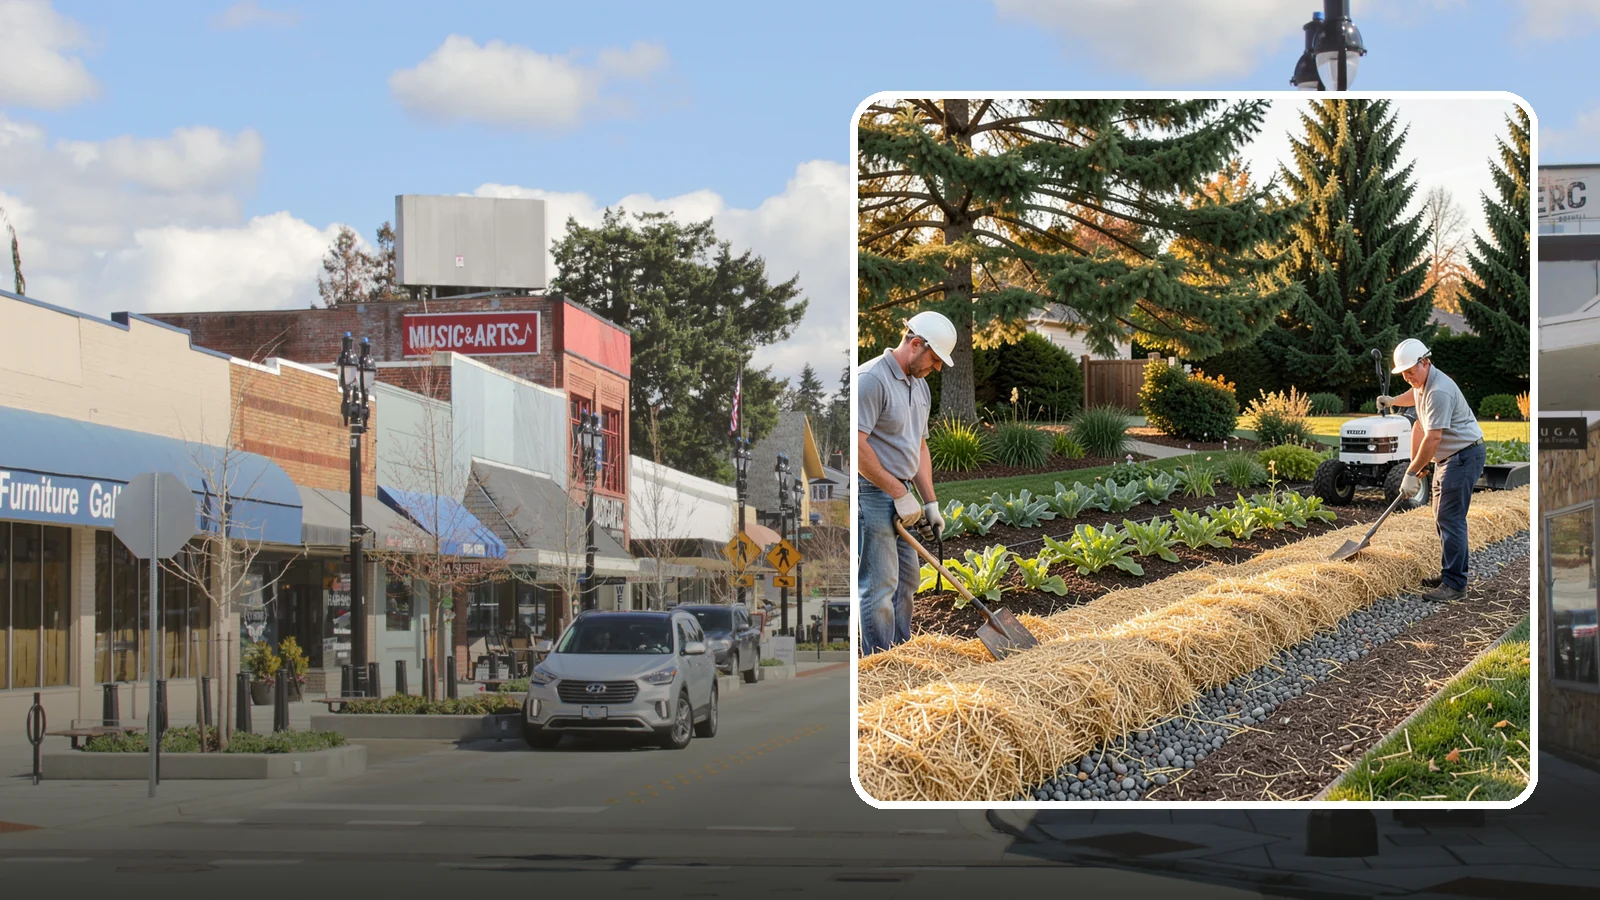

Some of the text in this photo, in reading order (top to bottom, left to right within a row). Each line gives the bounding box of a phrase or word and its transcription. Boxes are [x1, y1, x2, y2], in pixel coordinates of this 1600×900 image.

[0, 471, 122, 519] Furniture Gal
[453, 563, 479, 574] SUSHI
